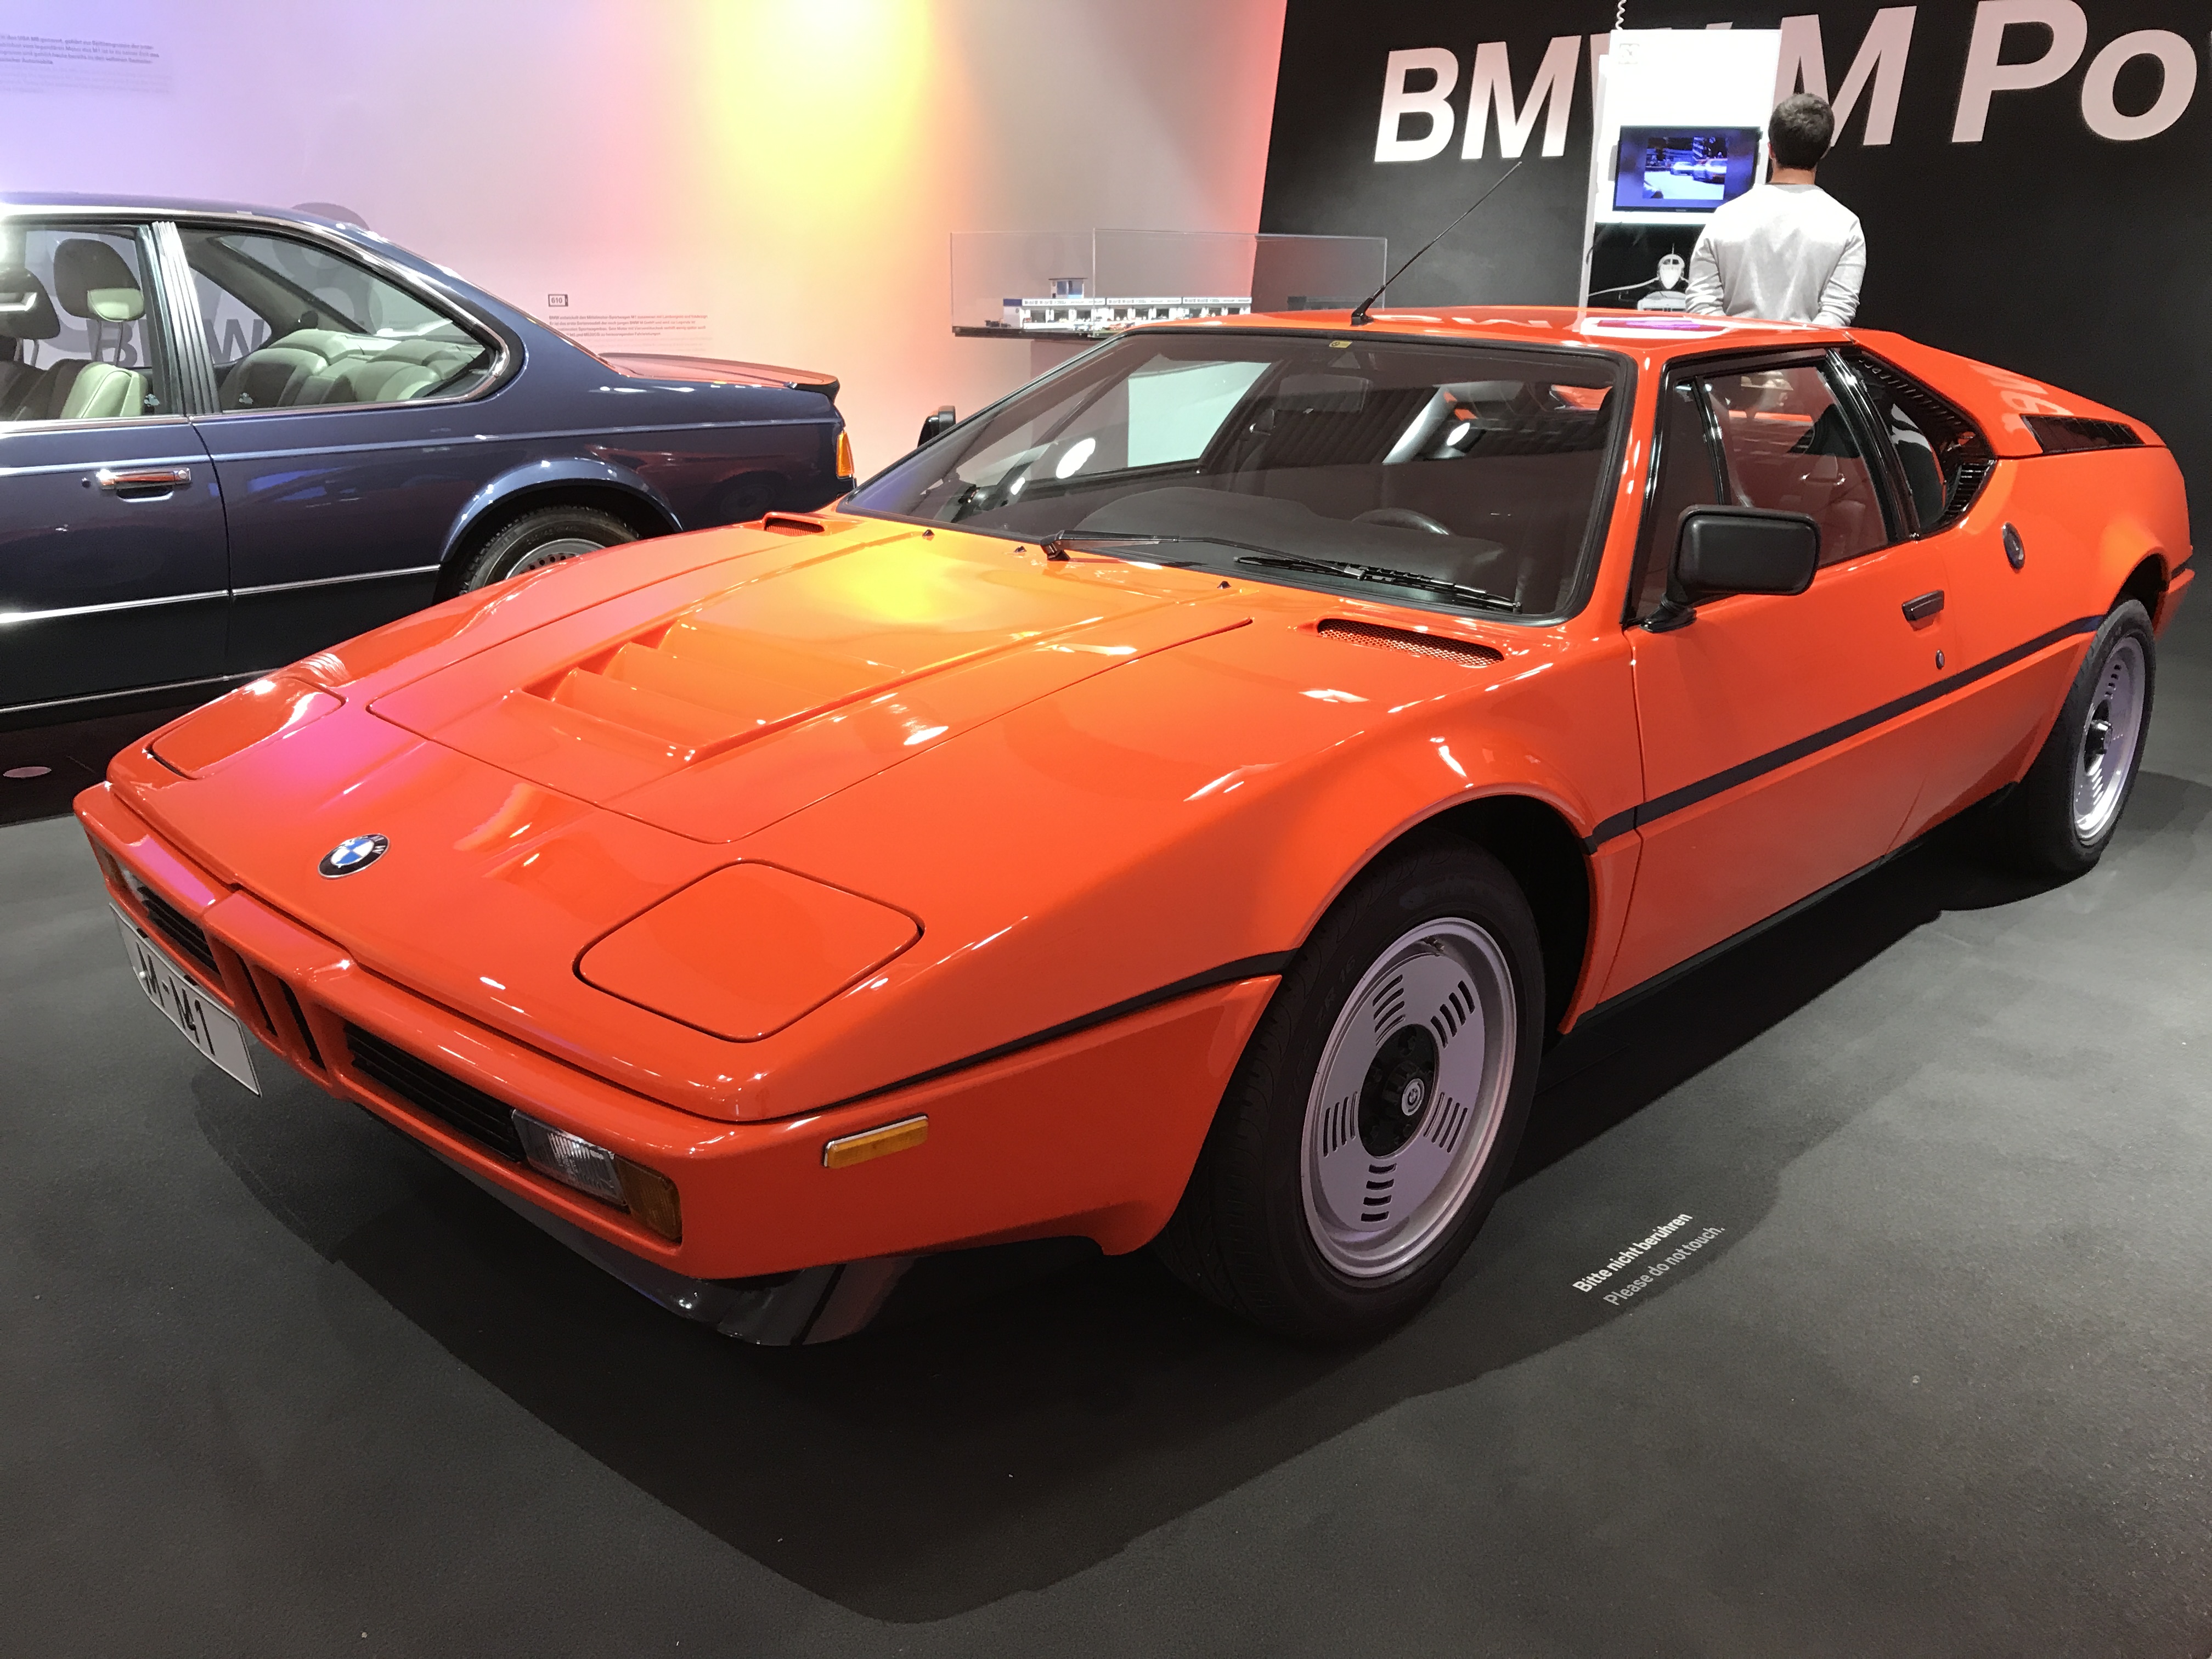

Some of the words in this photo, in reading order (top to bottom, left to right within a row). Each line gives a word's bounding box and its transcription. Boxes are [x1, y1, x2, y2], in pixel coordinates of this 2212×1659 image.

[1375, 22, 1732, 162] BM
[1952, 0, 2212, 143] Po
[87, 318, 264, 368] BW
[1572, 1269, 1613, 1293] Bitte
[1607, 1246, 1644, 1272] nicht
[1602, 1274, 1654, 1306] Please
[1647, 1263, 1670, 1276] do
[1664, 1248, 1692, 1266] not
[1681, 1226, 1726, 1252] touch.
